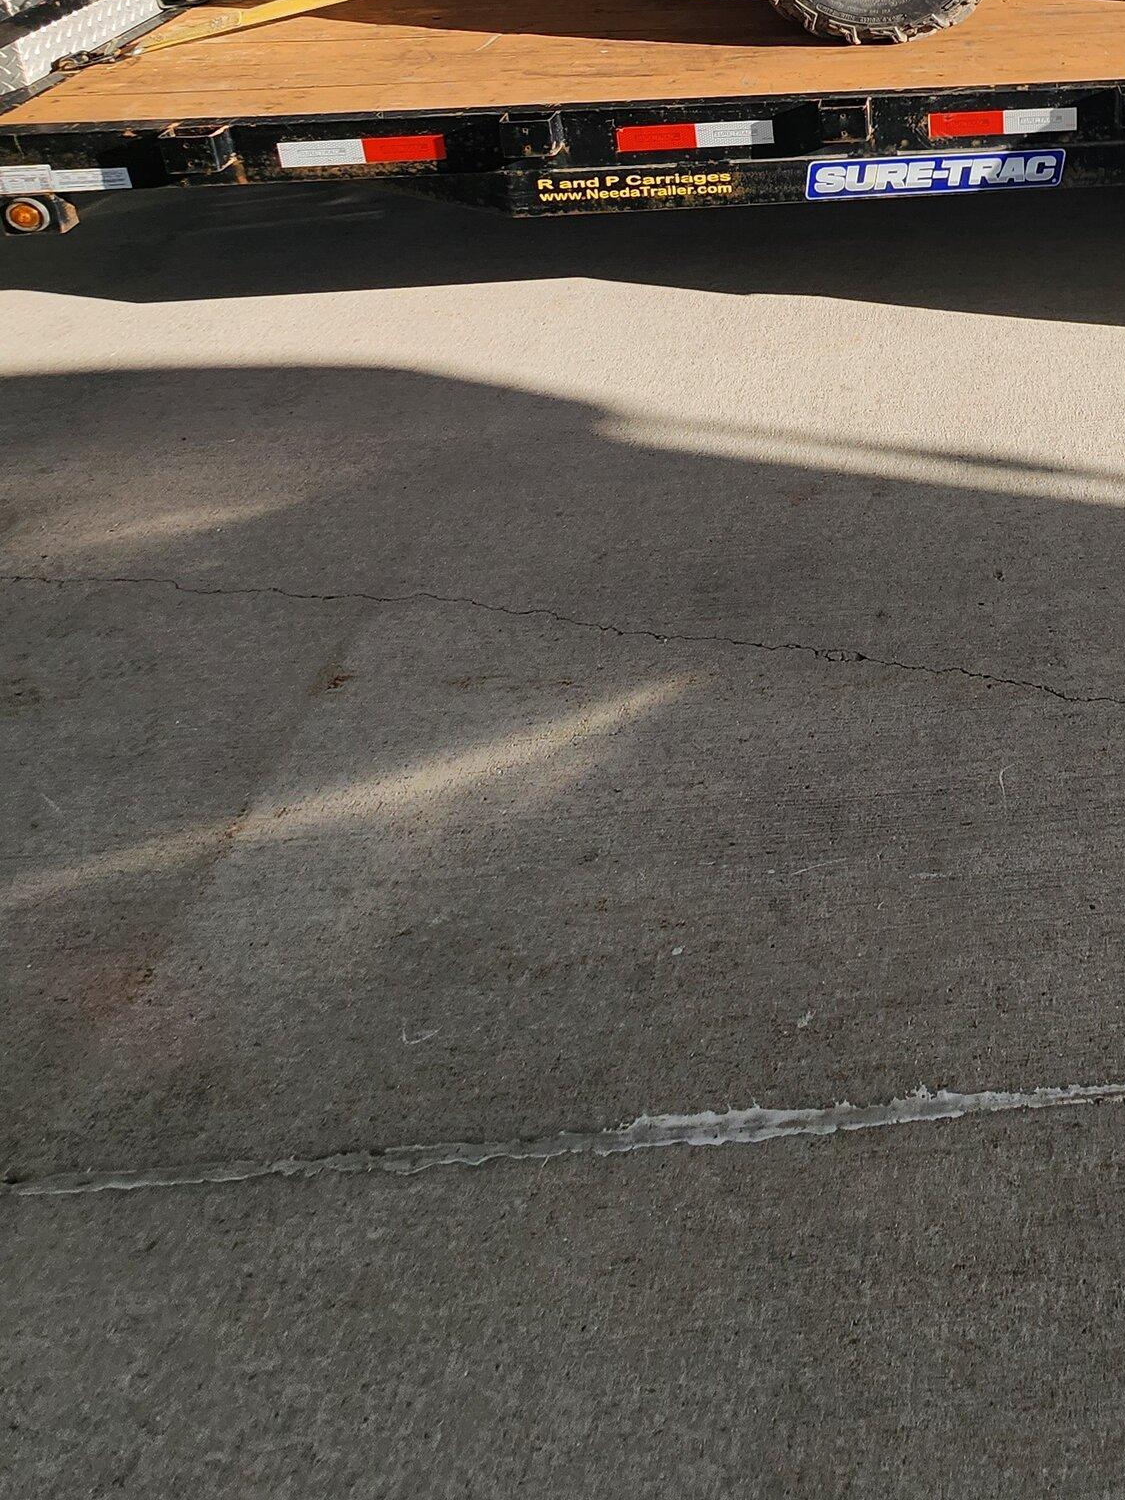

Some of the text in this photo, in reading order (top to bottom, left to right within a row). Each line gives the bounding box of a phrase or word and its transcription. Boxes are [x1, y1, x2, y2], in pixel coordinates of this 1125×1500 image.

[537, 172, 732, 190] R and P Carriages
[814, 155, 1057, 194] SURE-TRAC
